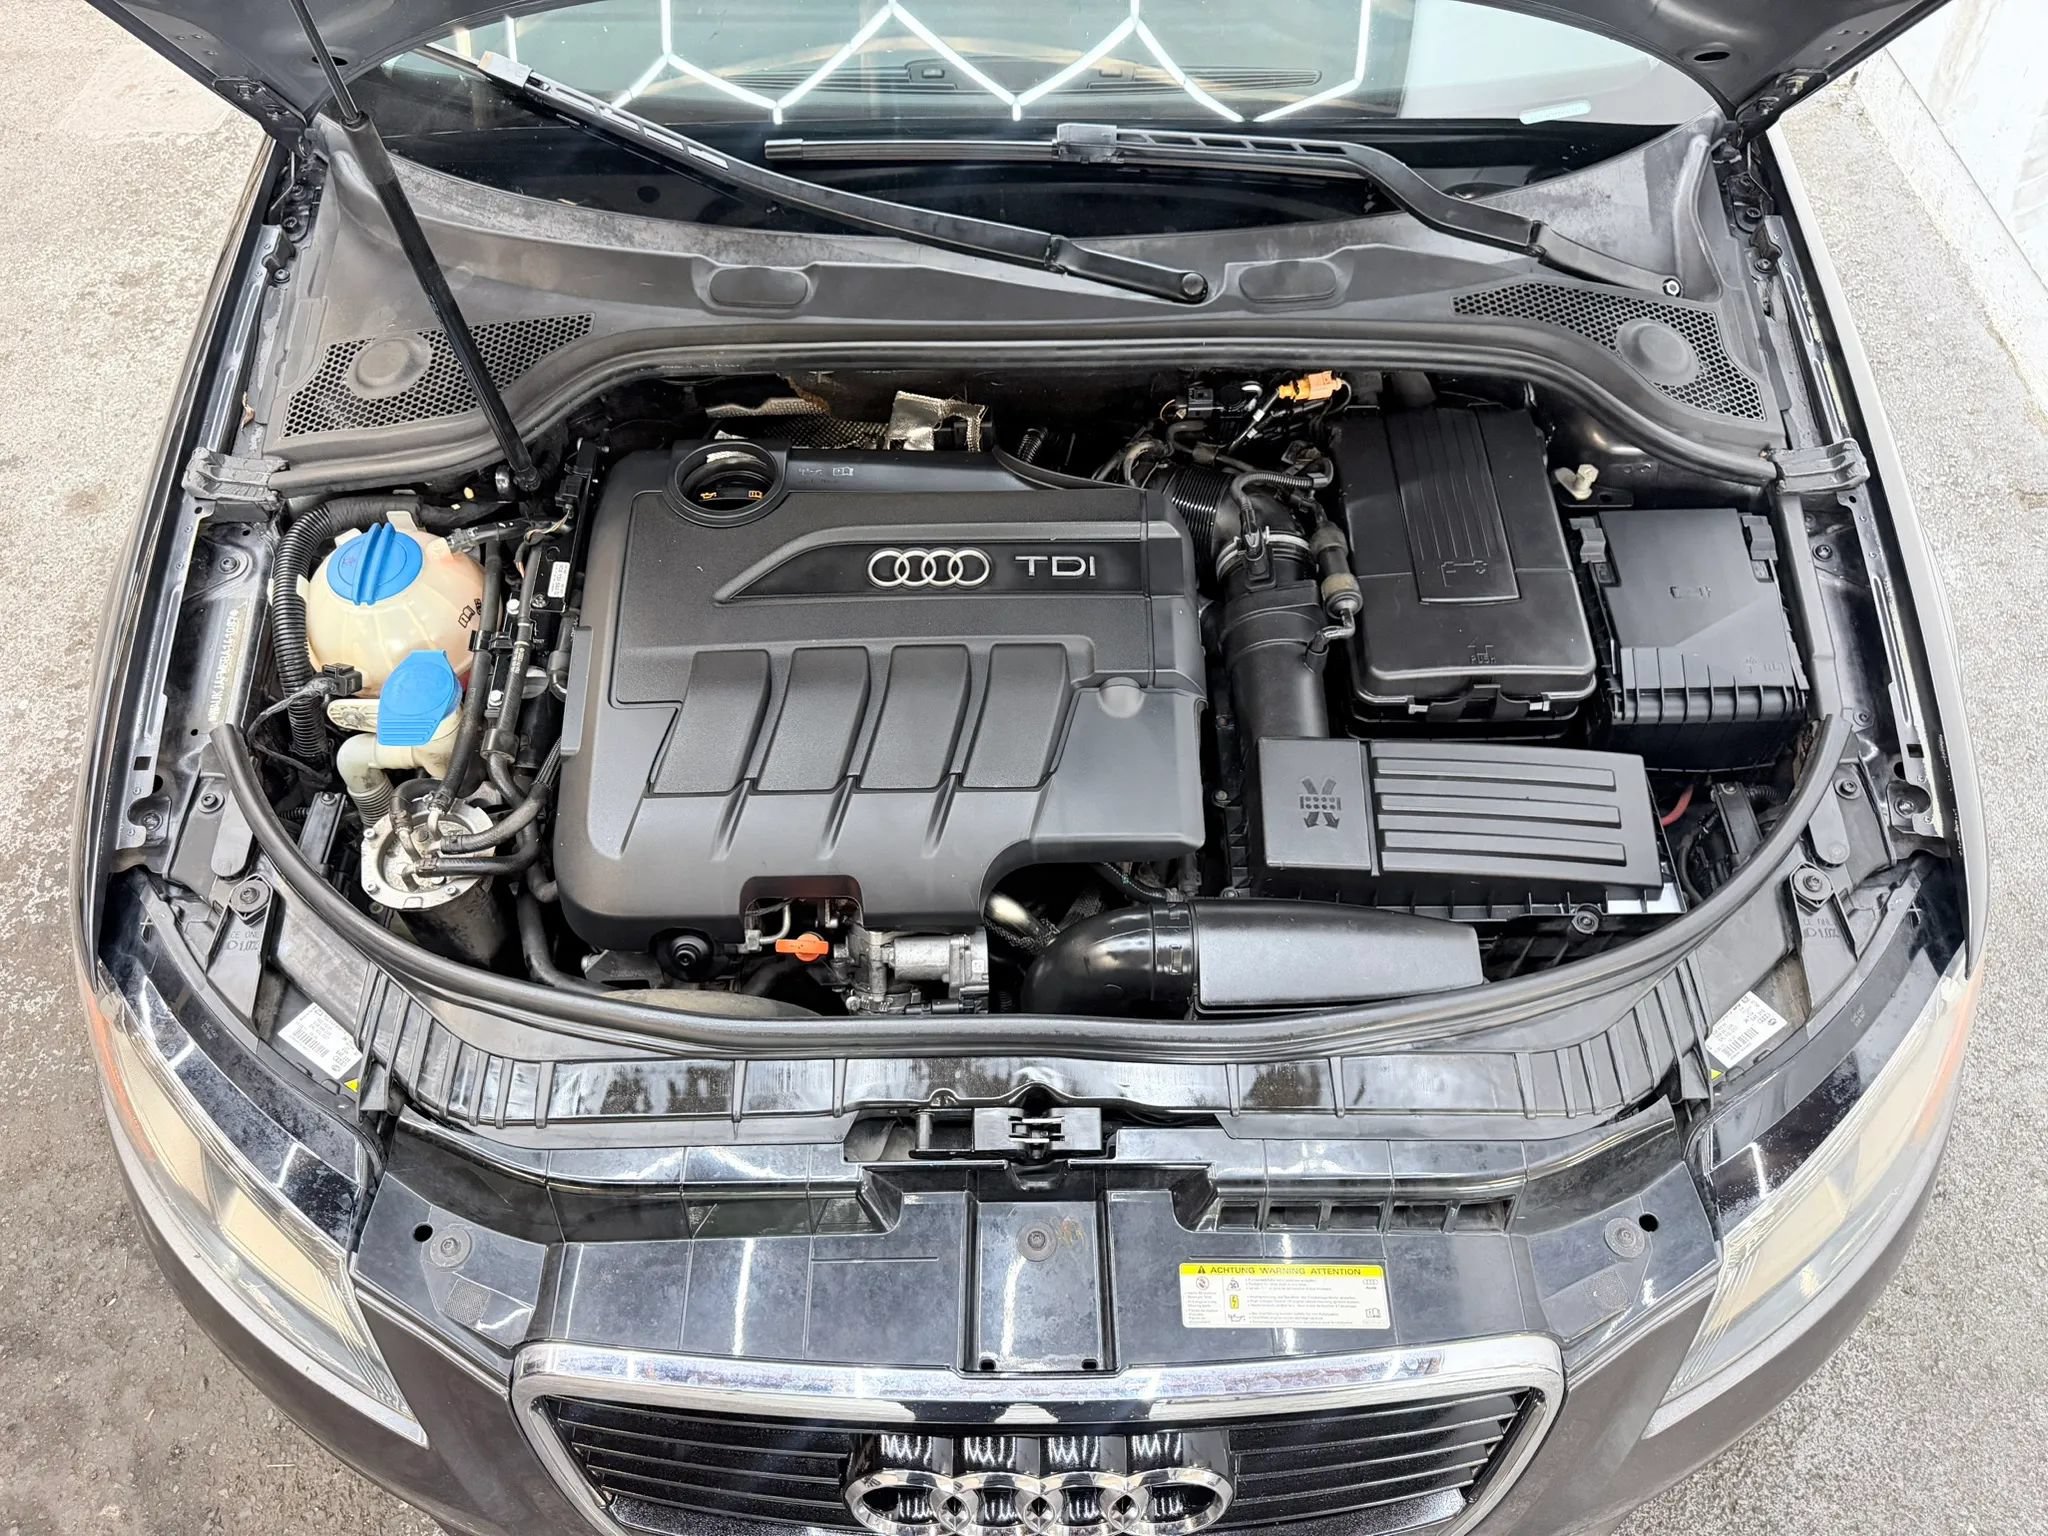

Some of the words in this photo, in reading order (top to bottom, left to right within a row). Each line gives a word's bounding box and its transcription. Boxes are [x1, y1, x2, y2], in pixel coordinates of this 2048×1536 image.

[1015, 555, 1096, 577] TDI
[1210, 1266, 1256, 1275] ACHTUNG
[1259, 1267, 1306, 1275] WARNING
[1310, 1267, 1361, 1276] ATTENTION
